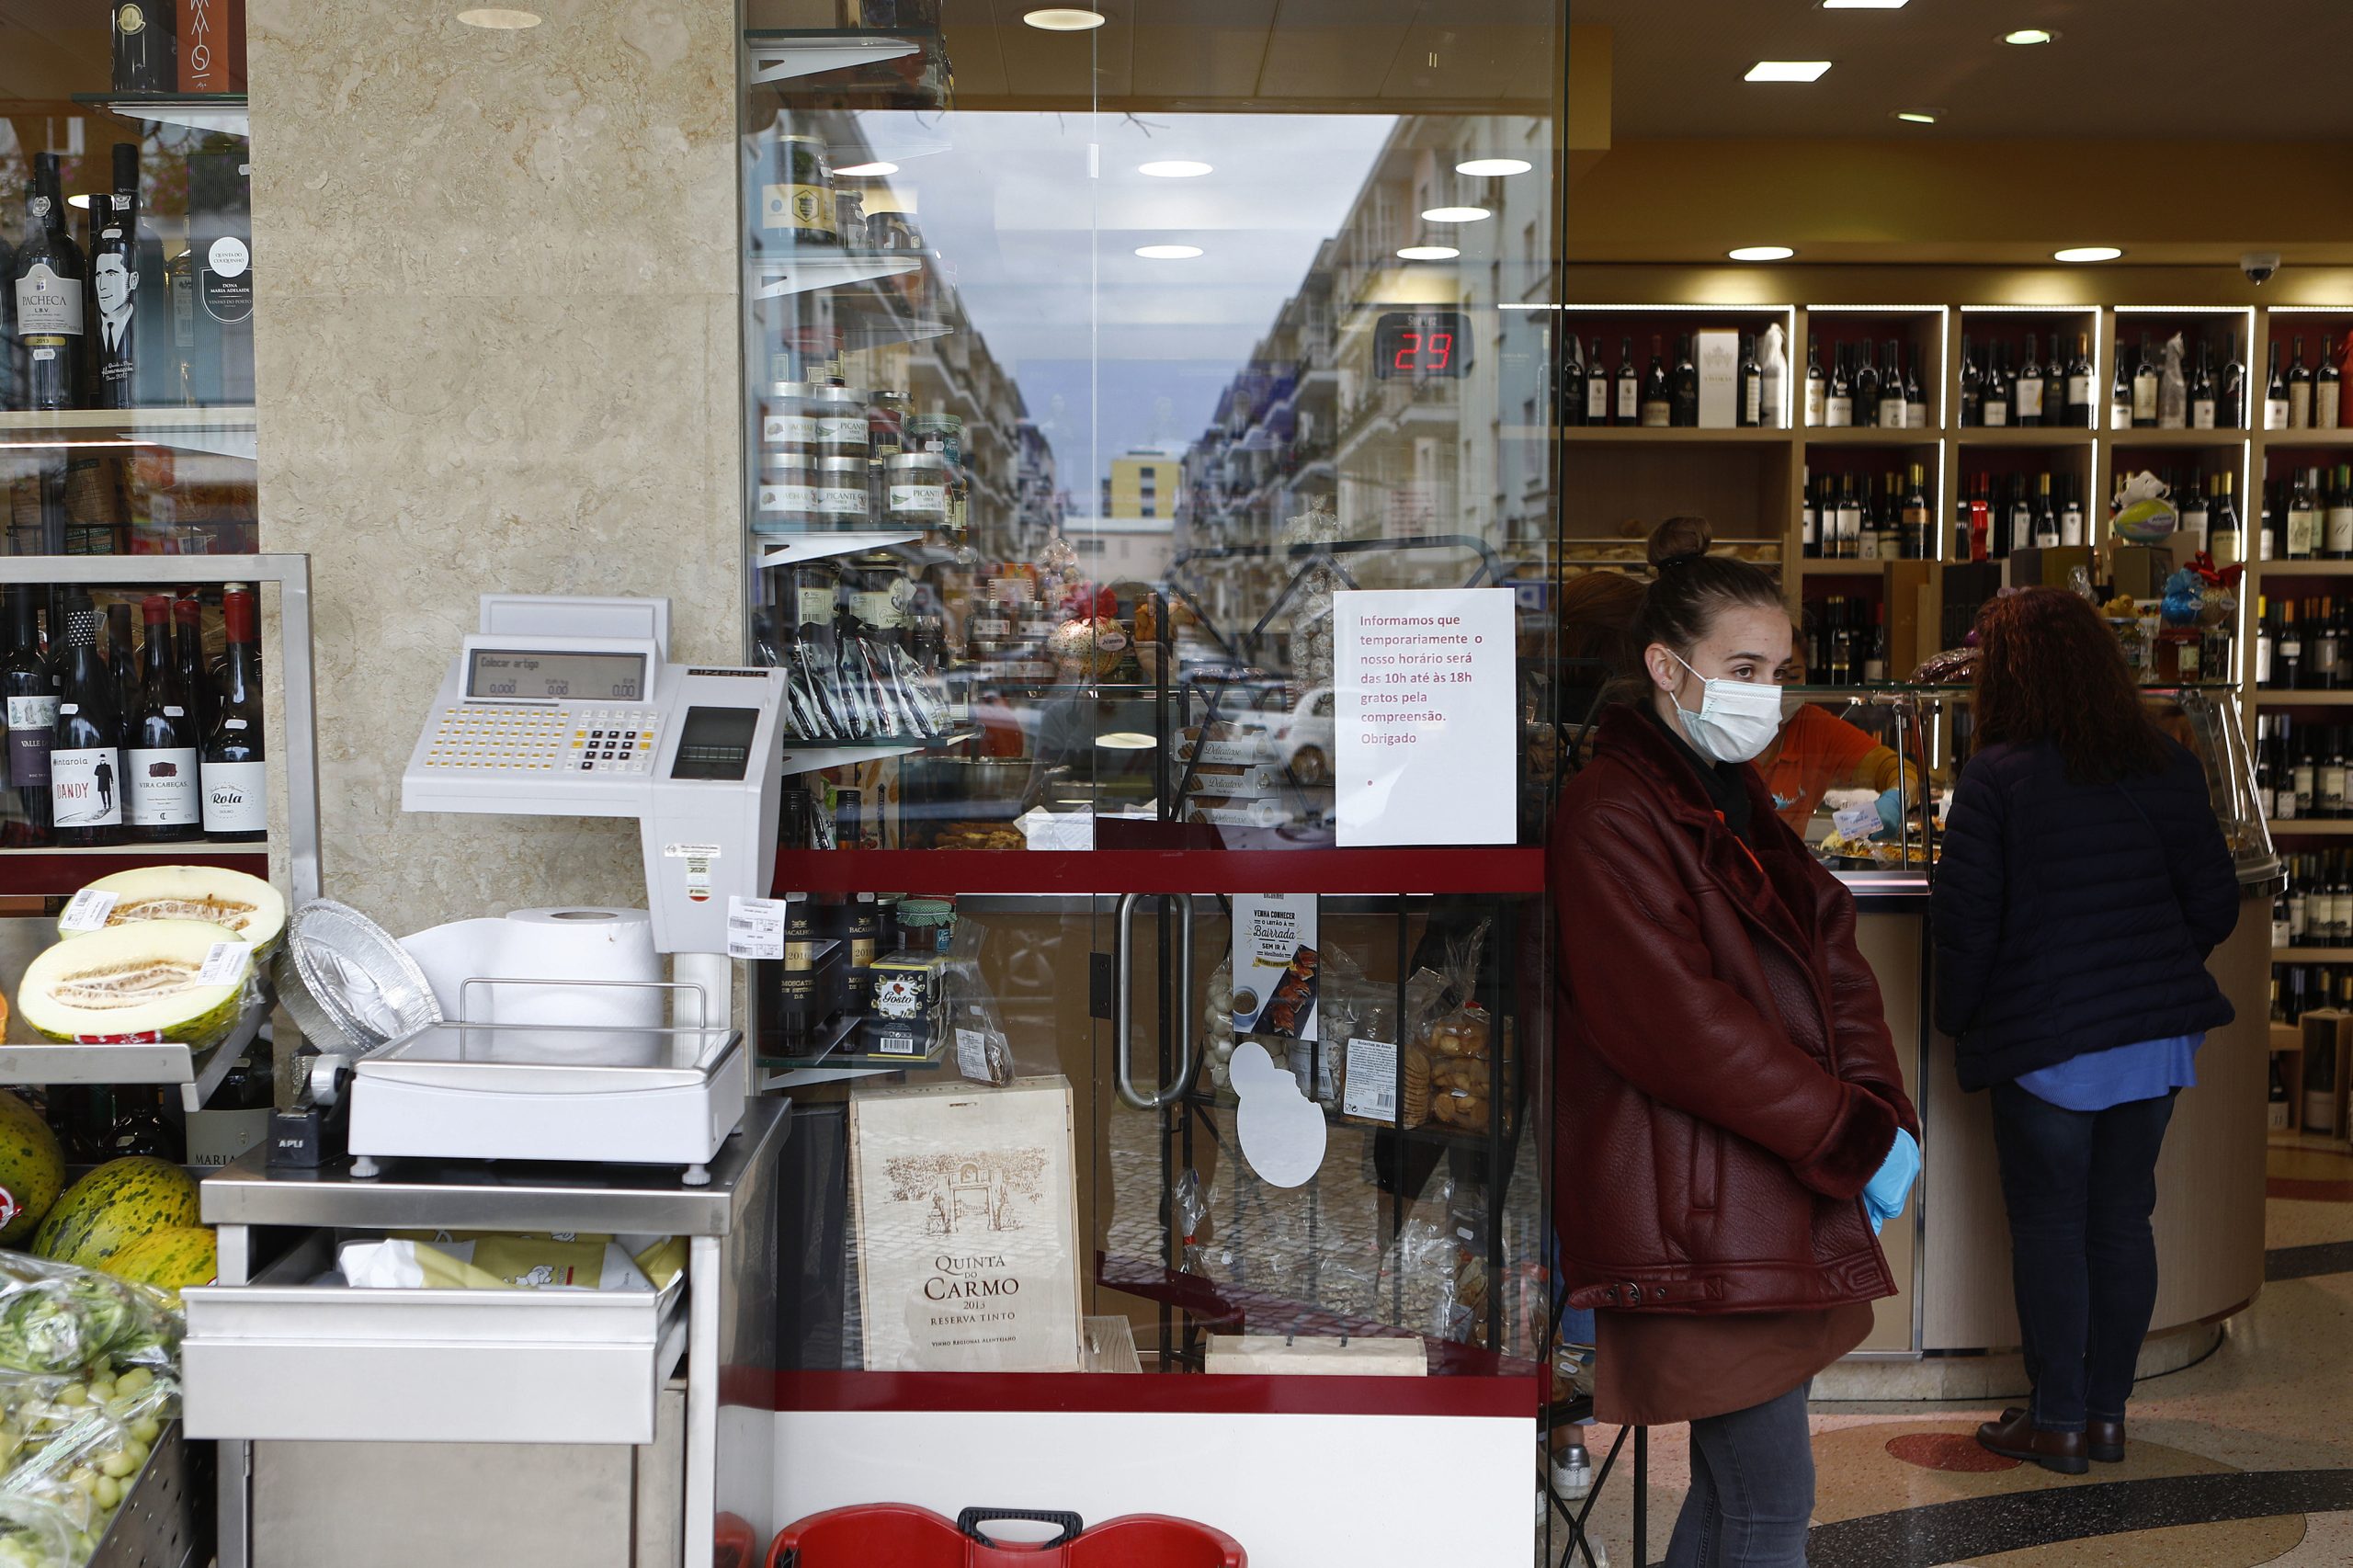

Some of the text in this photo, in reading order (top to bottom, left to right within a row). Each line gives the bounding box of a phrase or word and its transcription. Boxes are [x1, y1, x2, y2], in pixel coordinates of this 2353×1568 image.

[22, 295, 67, 306] PACHECA
[1394, 334, 1453, 369] 29
[1360, 615, 1461, 628] Informamos que
[1360, 634, 1483, 647] temporariamente o
[1360, 653, 1472, 665] nosso horário será
[688, 669, 768, 677] BIZERBA
[1360, 672, 1472, 684] das 10h até às 18h
[1360, 691, 1427, 706] gratos pela
[1361, 710, 1447, 724] compreensão.
[20, 740, 41, 748] VALLE
[1361, 733, 1416, 746] Obrigado
[56, 782, 89, 800] DANDY
[210, 792, 244, 804] Rola
[1270, 911, 1296, 919] CONHECER
[1254, 925, 1296, 939] Bairrada
[882, 992, 914, 1006] Gosto
[935, 1255, 1006, 1276] QUINTA
[924, 1278, 1019, 1301] CARMO
[930, 1312, 1016, 1325] RESERVA TINTO
